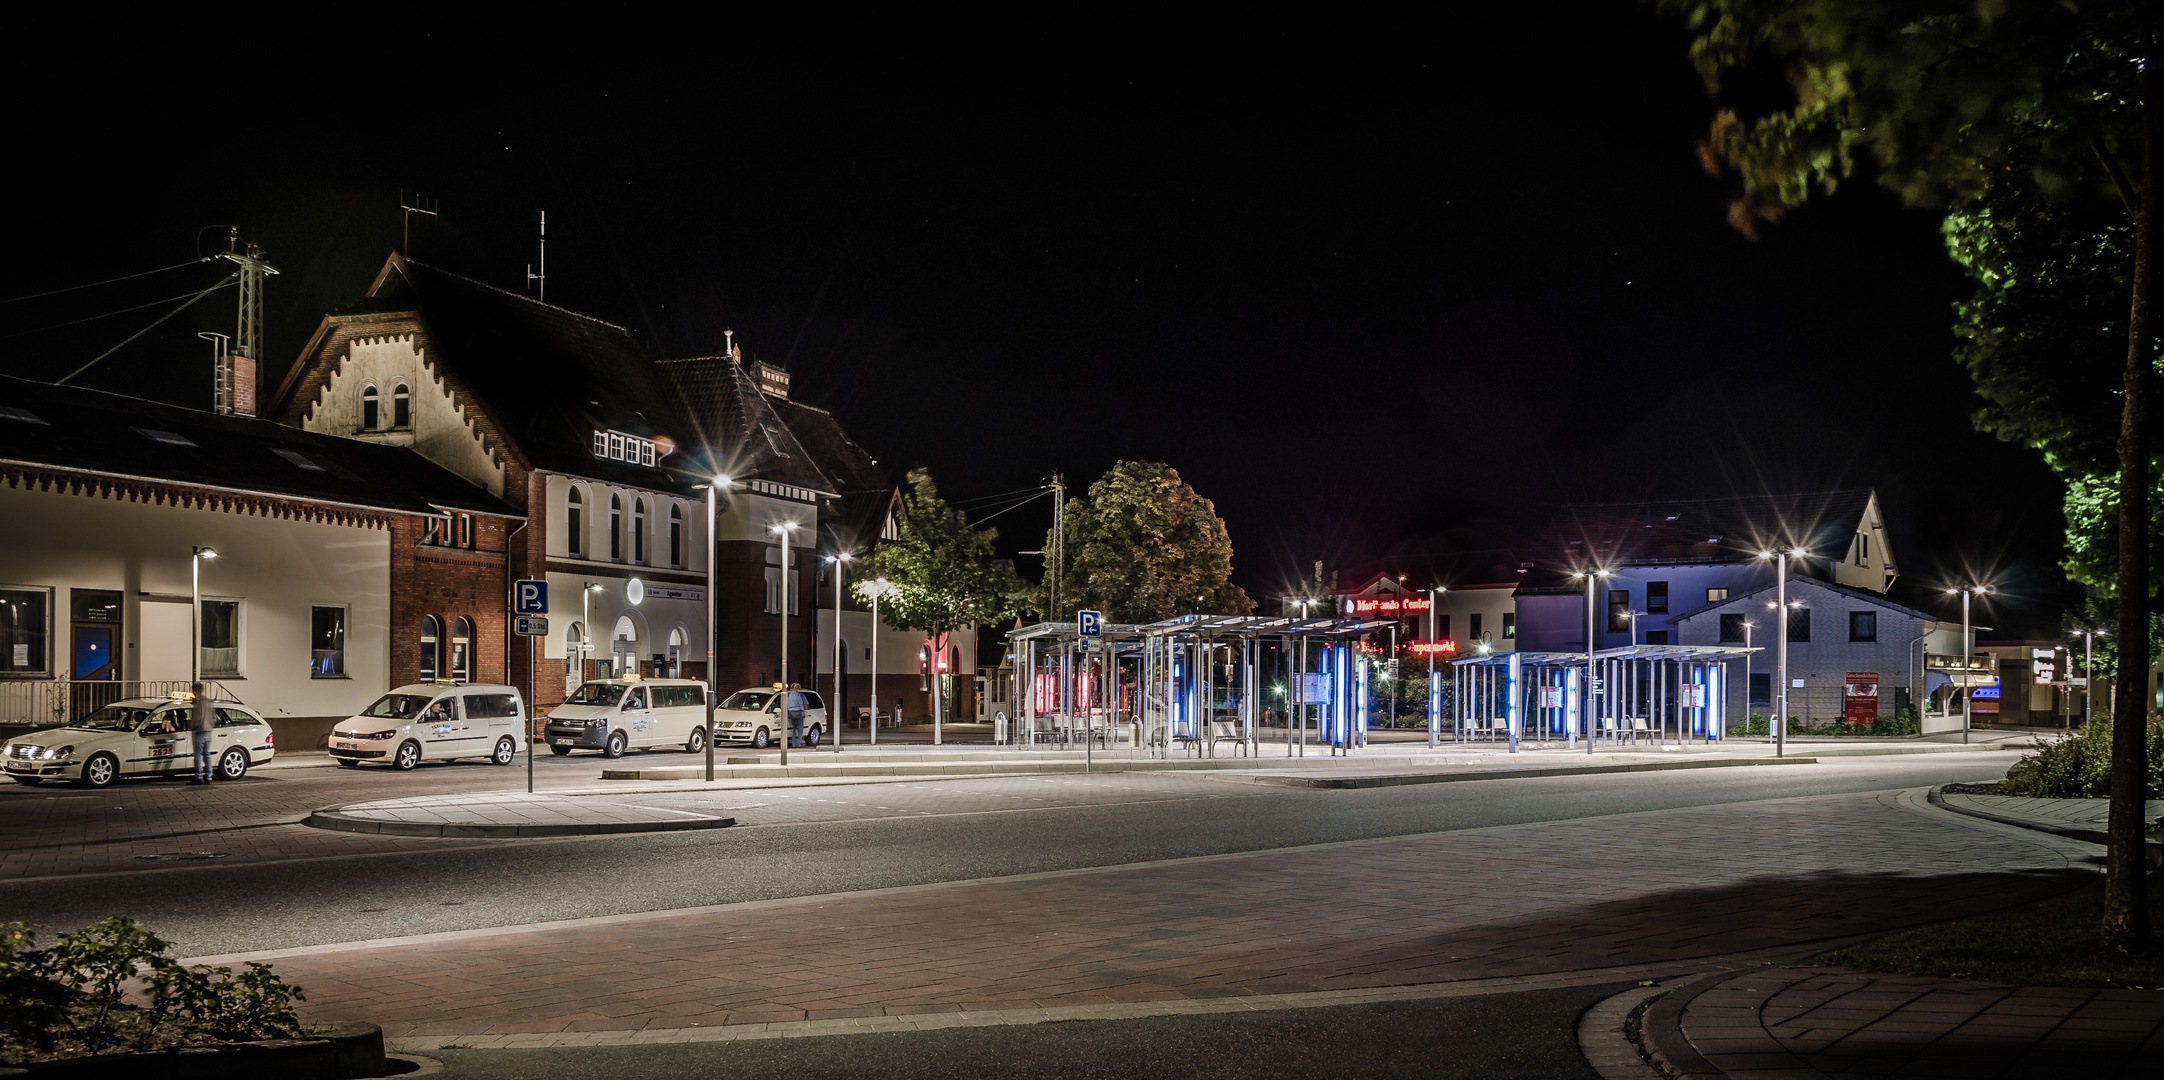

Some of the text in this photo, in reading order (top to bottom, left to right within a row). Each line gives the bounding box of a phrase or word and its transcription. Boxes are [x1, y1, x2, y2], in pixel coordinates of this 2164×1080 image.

[522, 584, 539, 609] P
[1403, 598, 1431, 609] Center
[1083, 614, 1095, 633] P
